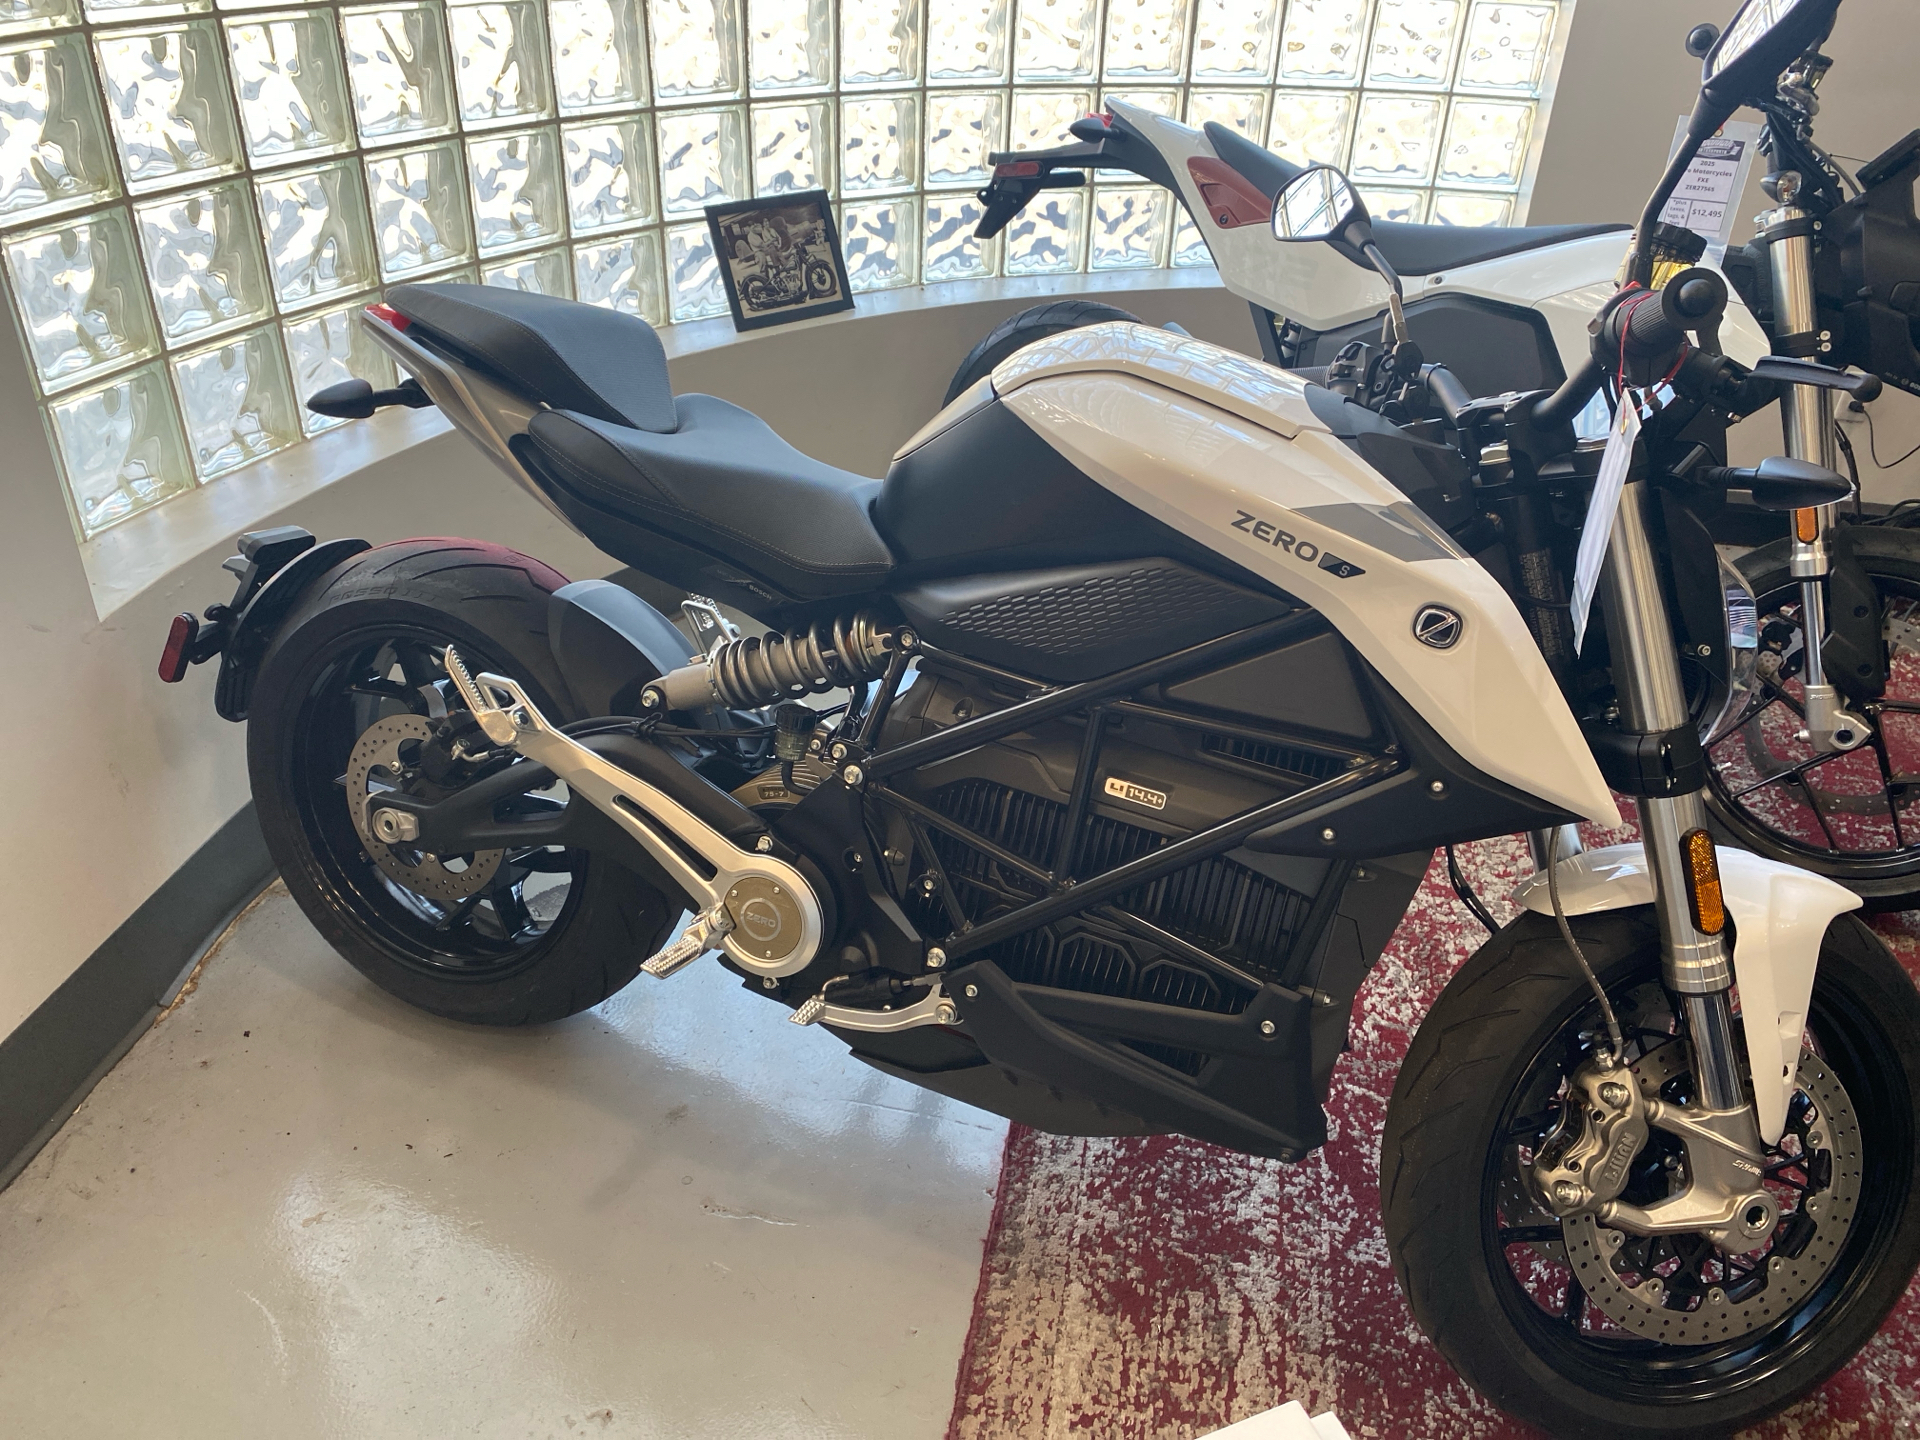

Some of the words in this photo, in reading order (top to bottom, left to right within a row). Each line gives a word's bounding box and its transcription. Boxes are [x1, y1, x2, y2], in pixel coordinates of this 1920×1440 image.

[1693, 168, 1732, 177] Motorcycles
[1685, 184, 1715, 192] ZER27565
[1692, 209, 1722, 218] $12,495
[1231, 509, 1319, 562] ZERO
[1339, 565, 1350, 576] S
[749, 584, 772, 600] BOSCH
[746, 911, 776, 928] ZERO
